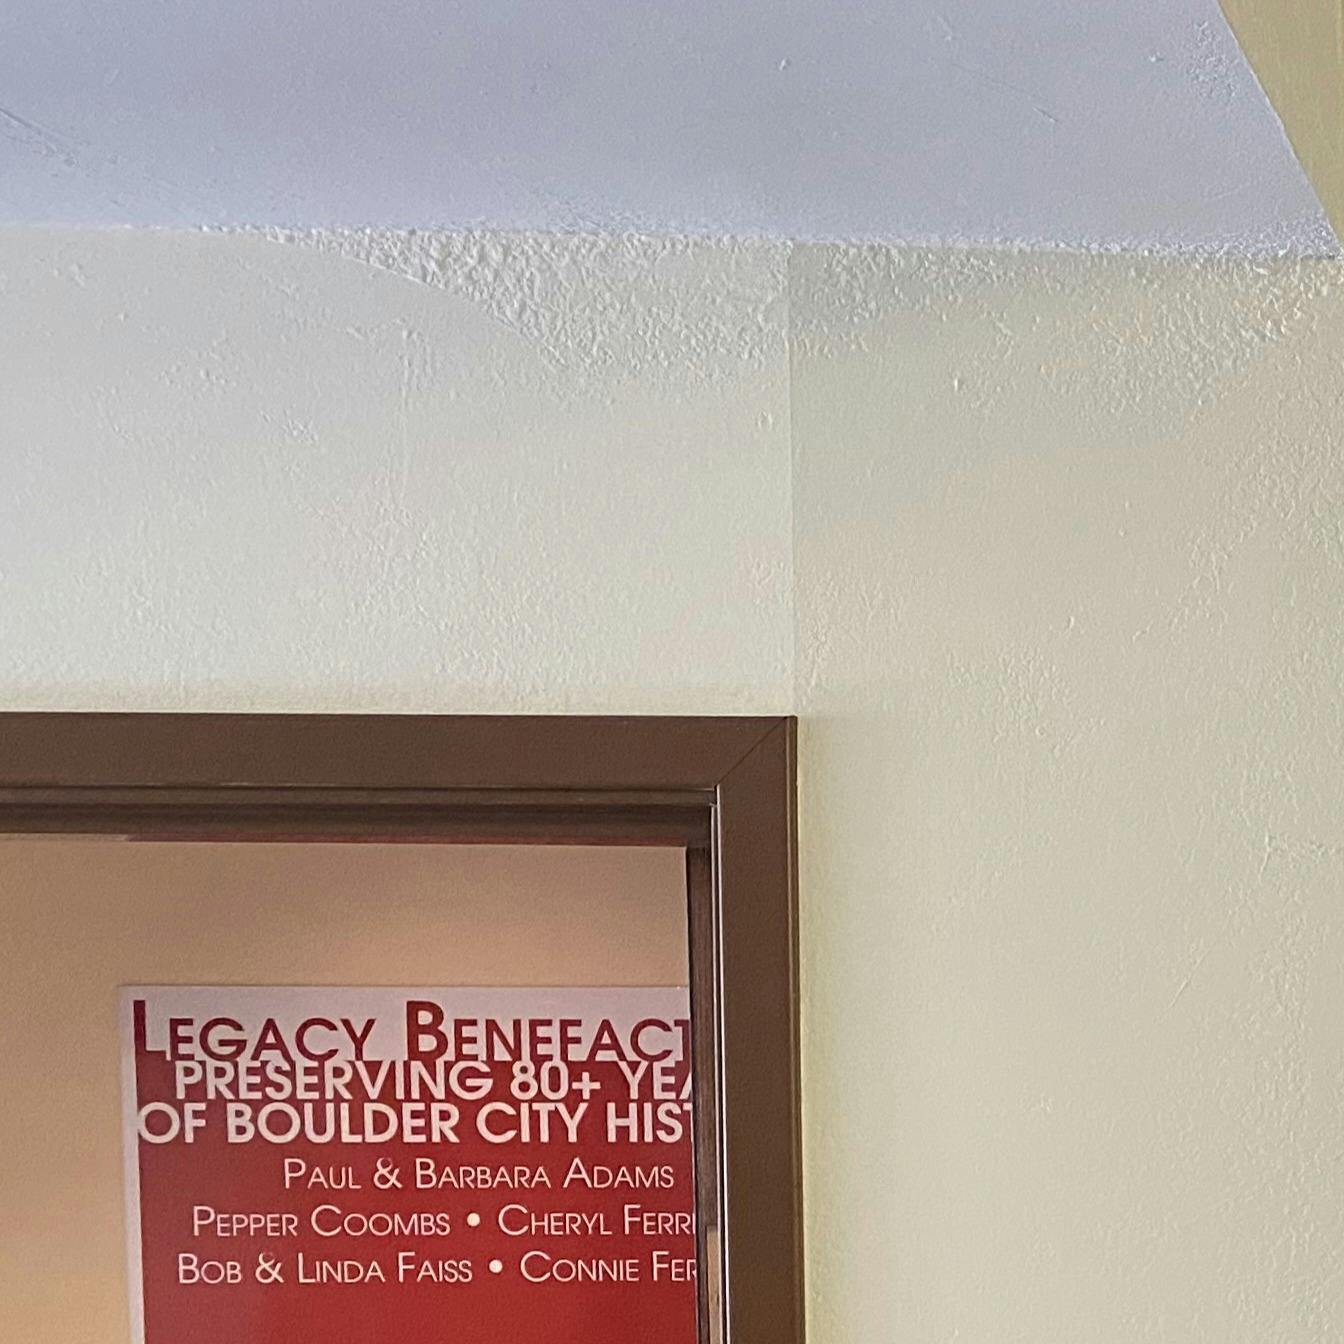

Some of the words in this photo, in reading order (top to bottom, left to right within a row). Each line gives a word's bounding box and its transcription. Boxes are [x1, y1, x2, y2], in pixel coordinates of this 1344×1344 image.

[133, 999, 376, 1062] LEGACY
[174, 1060, 492, 1100] PRESERVING
[509, 1059, 601, 1099] 80+
[138, 1103, 206, 1144] OF
[226, 1102, 460, 1144] BOULDER
[476, 1101, 589, 1143] CITY
[283, 1158, 362, 1190] PAUL
[373, 1157, 403, 1189] &
[415, 1157, 552, 1190] BARBARA
[563, 1156, 675, 1189] ADAMS
[193, 1205, 298, 1238] PEPPER
[311, 1203, 451, 1236] COOMBS
[498, 1203, 612, 1237] CHERYL
[623, 1203, 696, 1237] FERR
[178, 1253, 242, 1285] BOB
[255, 1252, 283, 1284] &
[297, 1252, 385, 1285] LINDA
[398, 1251, 474, 1283] FAISS
[520, 1250, 639, 1284] CONNIE
